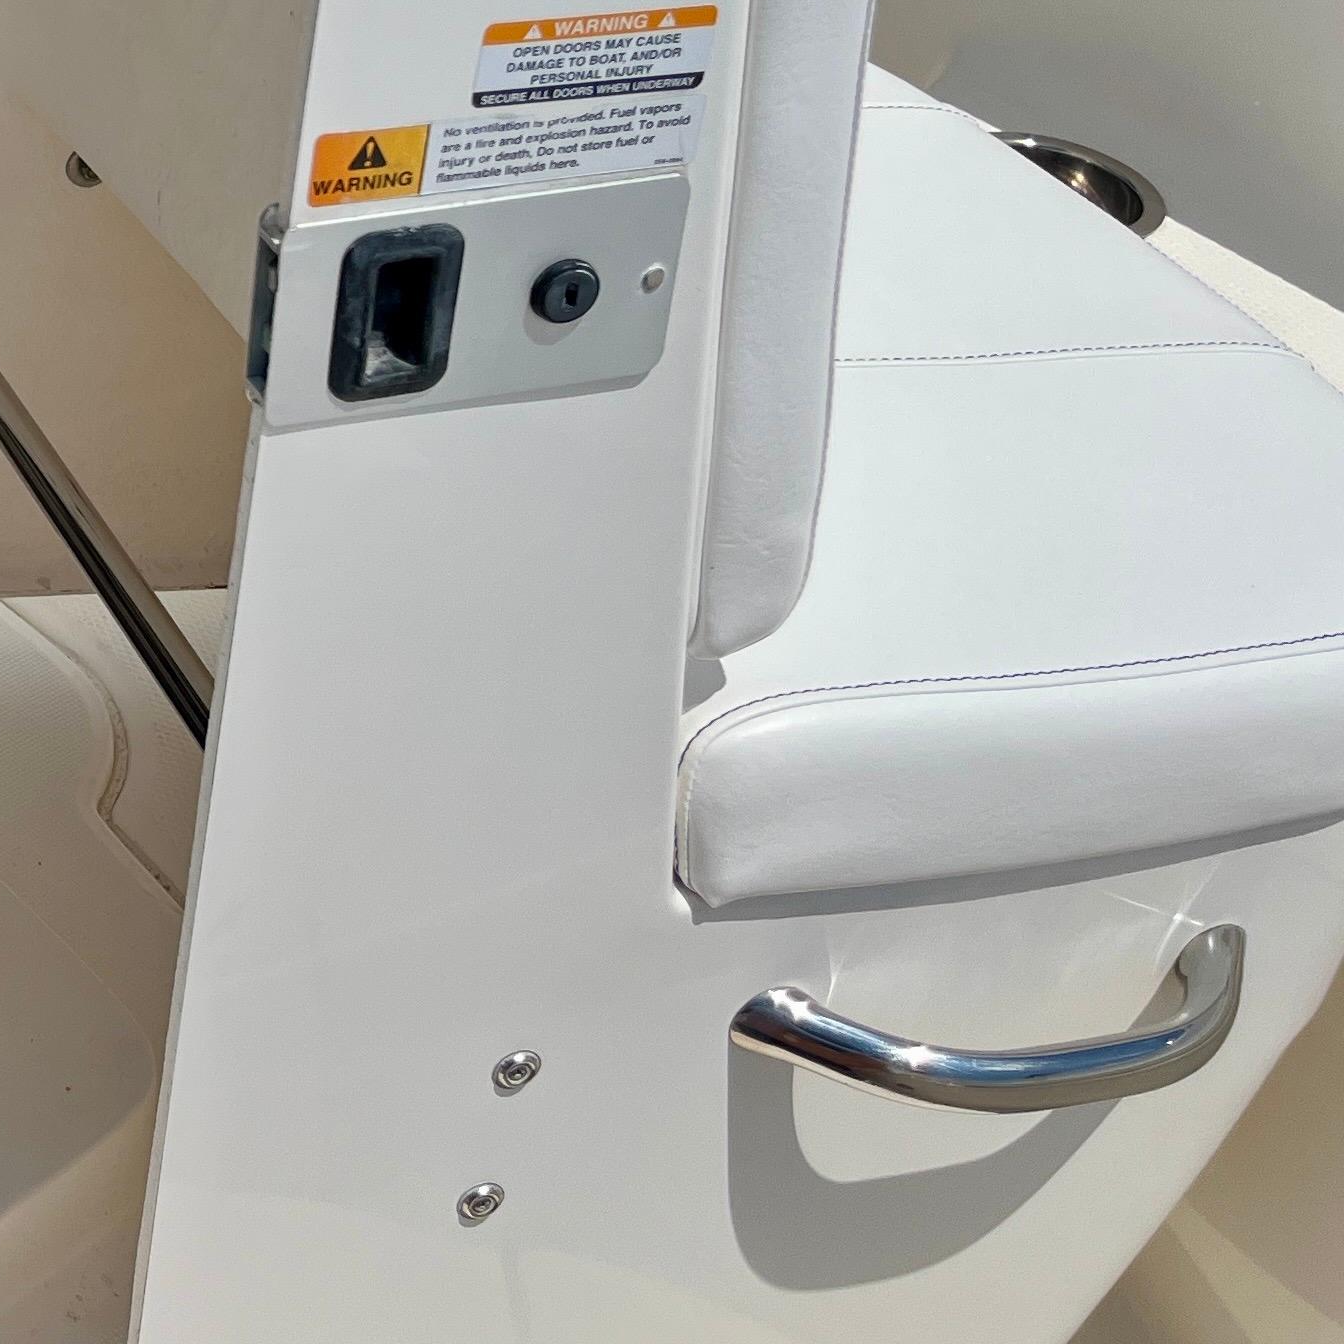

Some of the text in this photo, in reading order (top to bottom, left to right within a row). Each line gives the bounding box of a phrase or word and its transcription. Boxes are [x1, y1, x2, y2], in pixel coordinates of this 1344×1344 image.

[555, 14, 648, 37] WARNING
[513, 33, 682, 58] OPEN DOORS MAY CAUSE
[506, 58, 564, 73] DAMAGE
[569, 56, 586, 68] TO
[630, 48, 682, 62] AND/OR
[530, 64, 654, 85] PERSONAL INJURY
[480, 76, 696, 106] SECURE ALL DOORS WHEN UNDERWAY
[443, 128, 462, 138] No
[465, 120, 530, 136] ventilation
[548, 110, 605, 128] provided.
[609, 105, 637, 119] Fuel
[639, 103, 683, 117] vapors
[441, 115, 692, 154] are a fire and explosion hazard. To avoid
[438, 157, 475, 170] injury
[478, 154, 492, 163] or
[537, 146, 555, 157] Do
[558, 143, 579, 155] not
[581, 140, 613, 152] store
[615, 136, 639, 148] fuel
[641, 134, 656, 145] or
[436, 158, 580, 183] flammable liquids here.
[312, 171, 414, 196] WARNING
